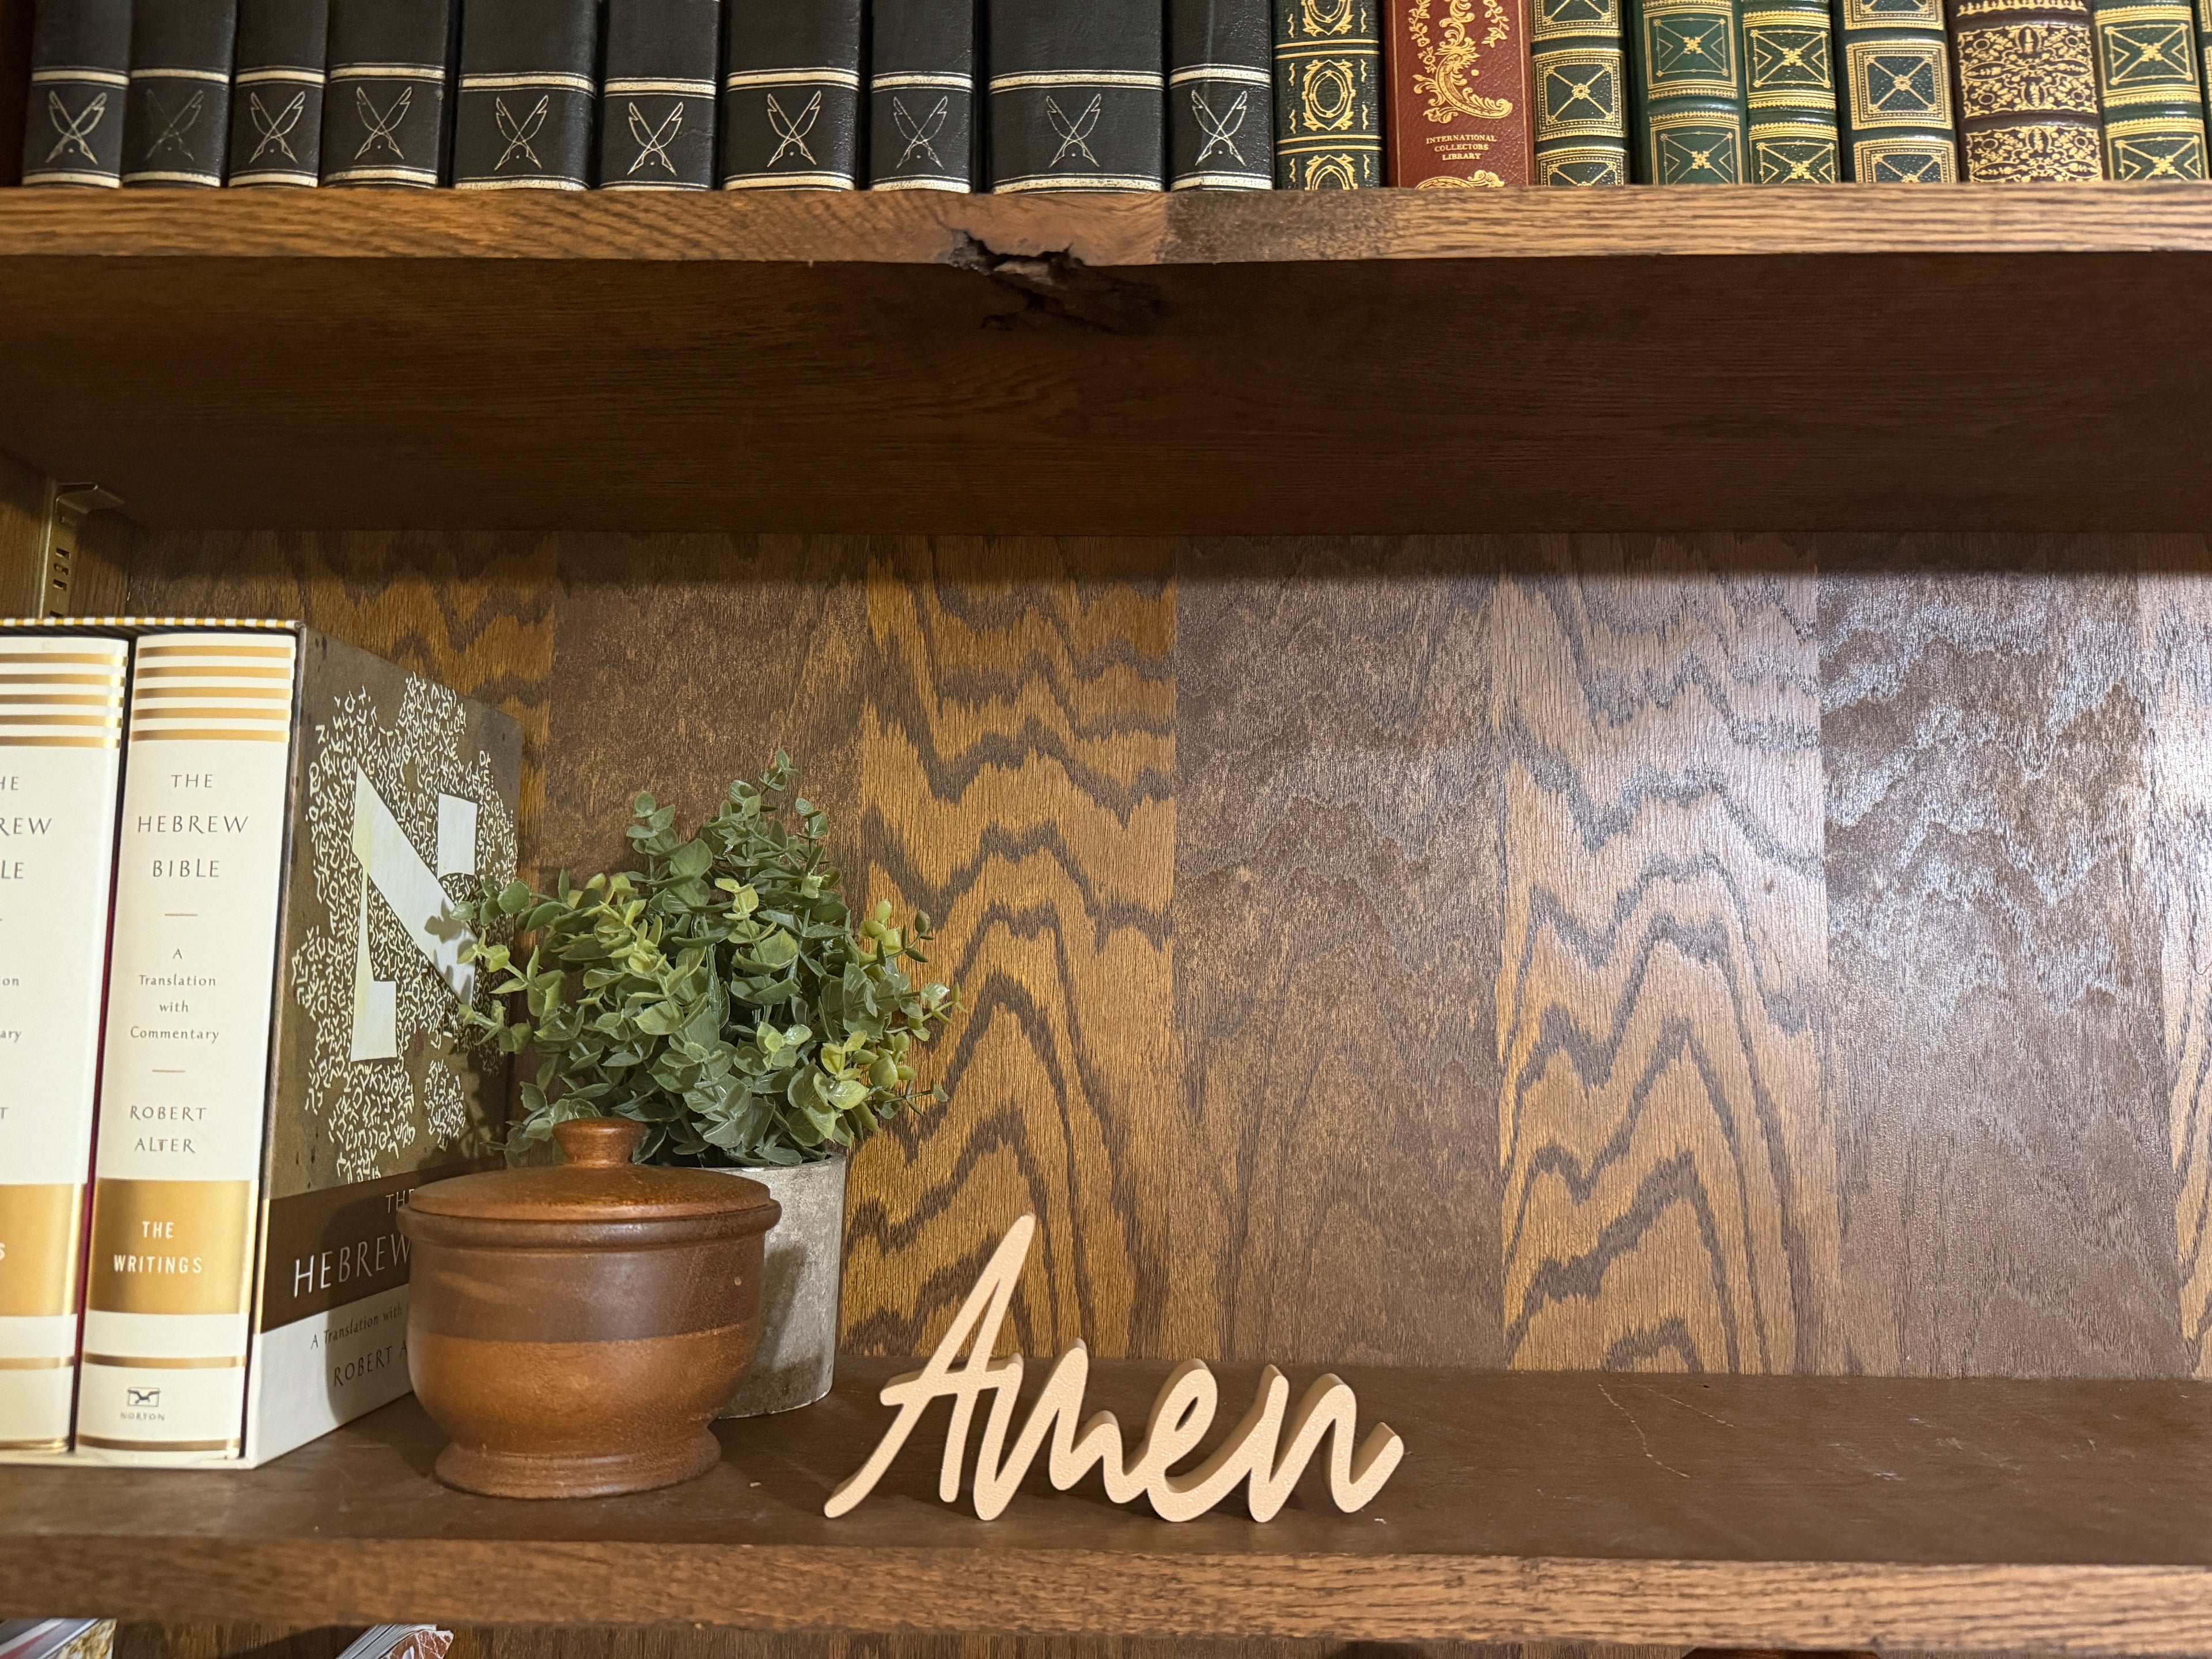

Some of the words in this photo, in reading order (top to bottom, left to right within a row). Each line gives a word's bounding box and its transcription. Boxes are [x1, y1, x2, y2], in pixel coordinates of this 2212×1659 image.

[1426, 134, 1497, 144] INTERNATIONAL
[1434, 143, 1489, 152] COLLECTORS
[1442, 153, 1482, 161] LIBRARY
[171, 774, 213, 788] THE
[137, 816, 249, 834] HEBREW
[153, 858, 220, 878] BIBLE
[173, 948, 183, 960] A
[139, 974, 217, 987] Translation
[159, 1000, 189, 1013] with
[130, 1026, 219, 1044] Commentary
[130, 1105, 207, 1122] ROBERT
[134, 1137, 196, 1154] ALTER
[142, 1221, 175, 1239] THE
[113, 1254, 203, 1275] WRITINGS
[294, 1233, 411, 1298] HEBREW
[310, 1334, 319, 1350] A
[324, 1316, 379, 1344] Translation
[382, 1301, 403, 1321] with
[334, 1345, 393, 1387] ROBERT
[824, 1211, 1404, 1522] Amen
[120, 1412, 165, 1421] NORTON
